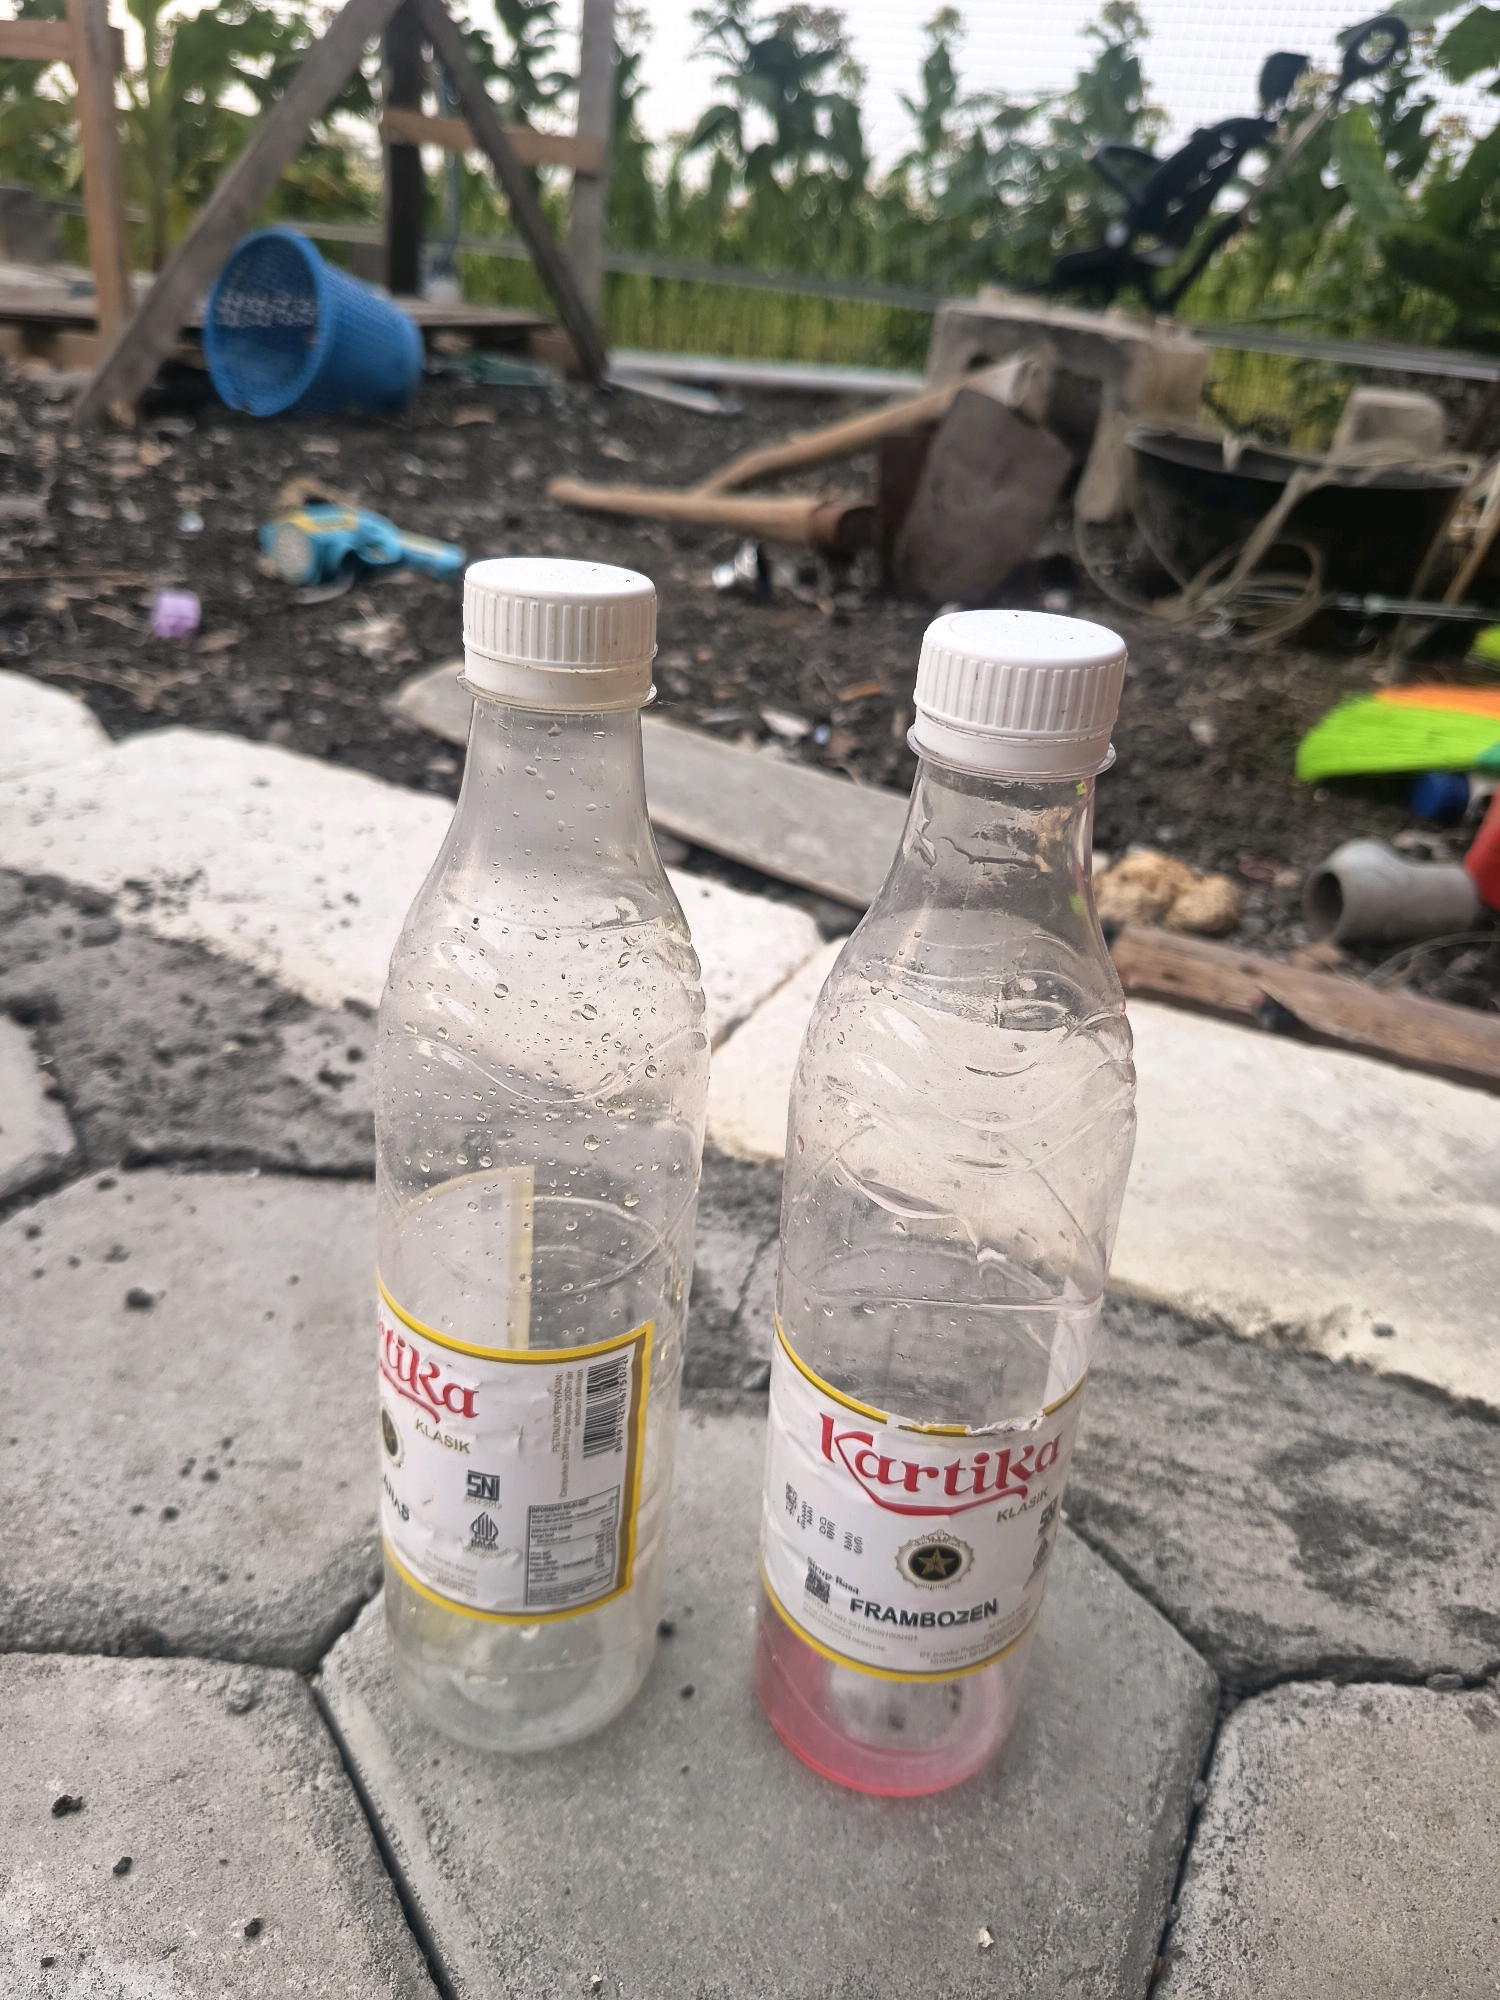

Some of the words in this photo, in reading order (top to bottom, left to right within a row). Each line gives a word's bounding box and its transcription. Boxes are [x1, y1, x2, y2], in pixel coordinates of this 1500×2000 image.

[414, 1418, 471, 1454] KLASIK
[552, 1415, 562, 1452] PETUNJUK
[819, 1412, 1063, 1514] Kartika
[467, 1469, 500, 1501] SNI
[996, 1485, 1048, 1523] KLASIK
[850, 1596, 998, 1629] FRAMBOZEN
